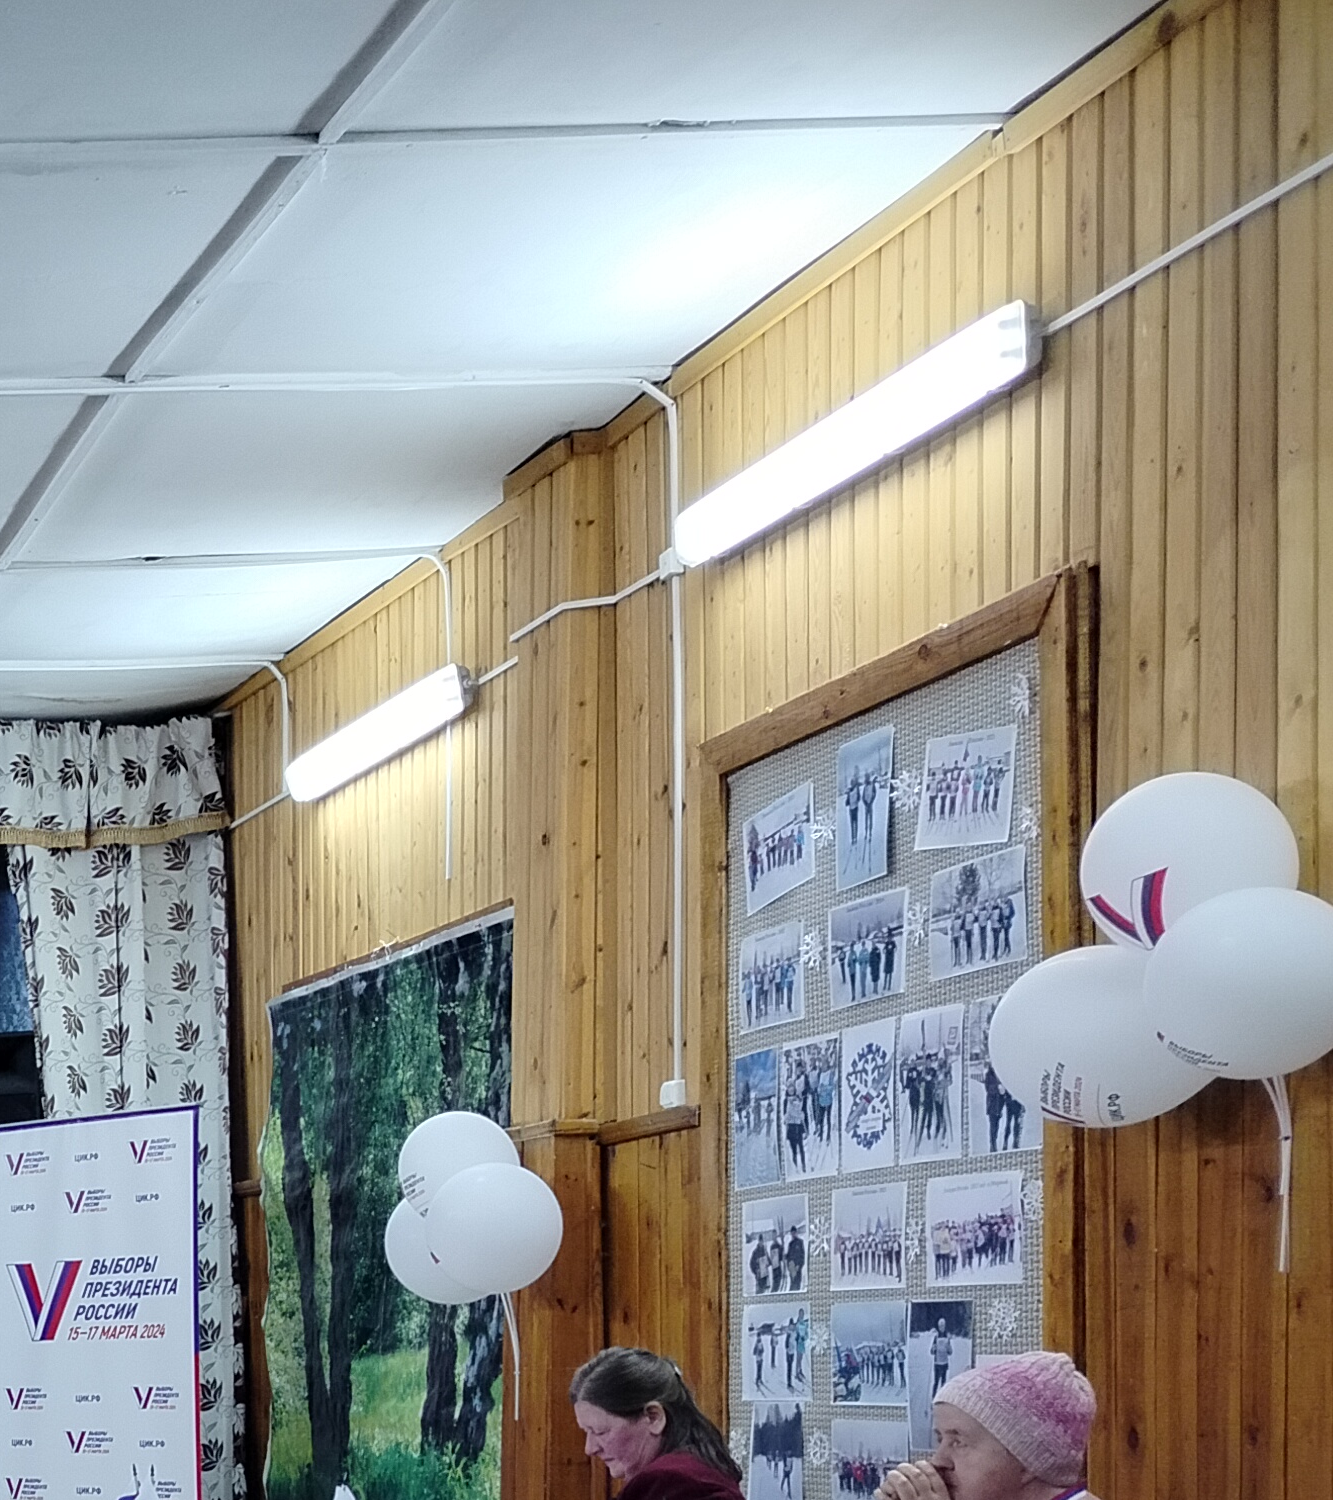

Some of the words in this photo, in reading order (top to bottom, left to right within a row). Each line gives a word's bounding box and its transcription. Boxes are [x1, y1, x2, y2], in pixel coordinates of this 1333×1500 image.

[89, 1255, 158, 1275] ВЫБОРЫ
[82, 1278, 179, 1299] ПРЕЗИДЕНТА
[73, 1302, 139, 1321] РОССИИ
[99, 1324, 138, 1340] МАРТА
[140, 1324, 166, 1339] 2024
